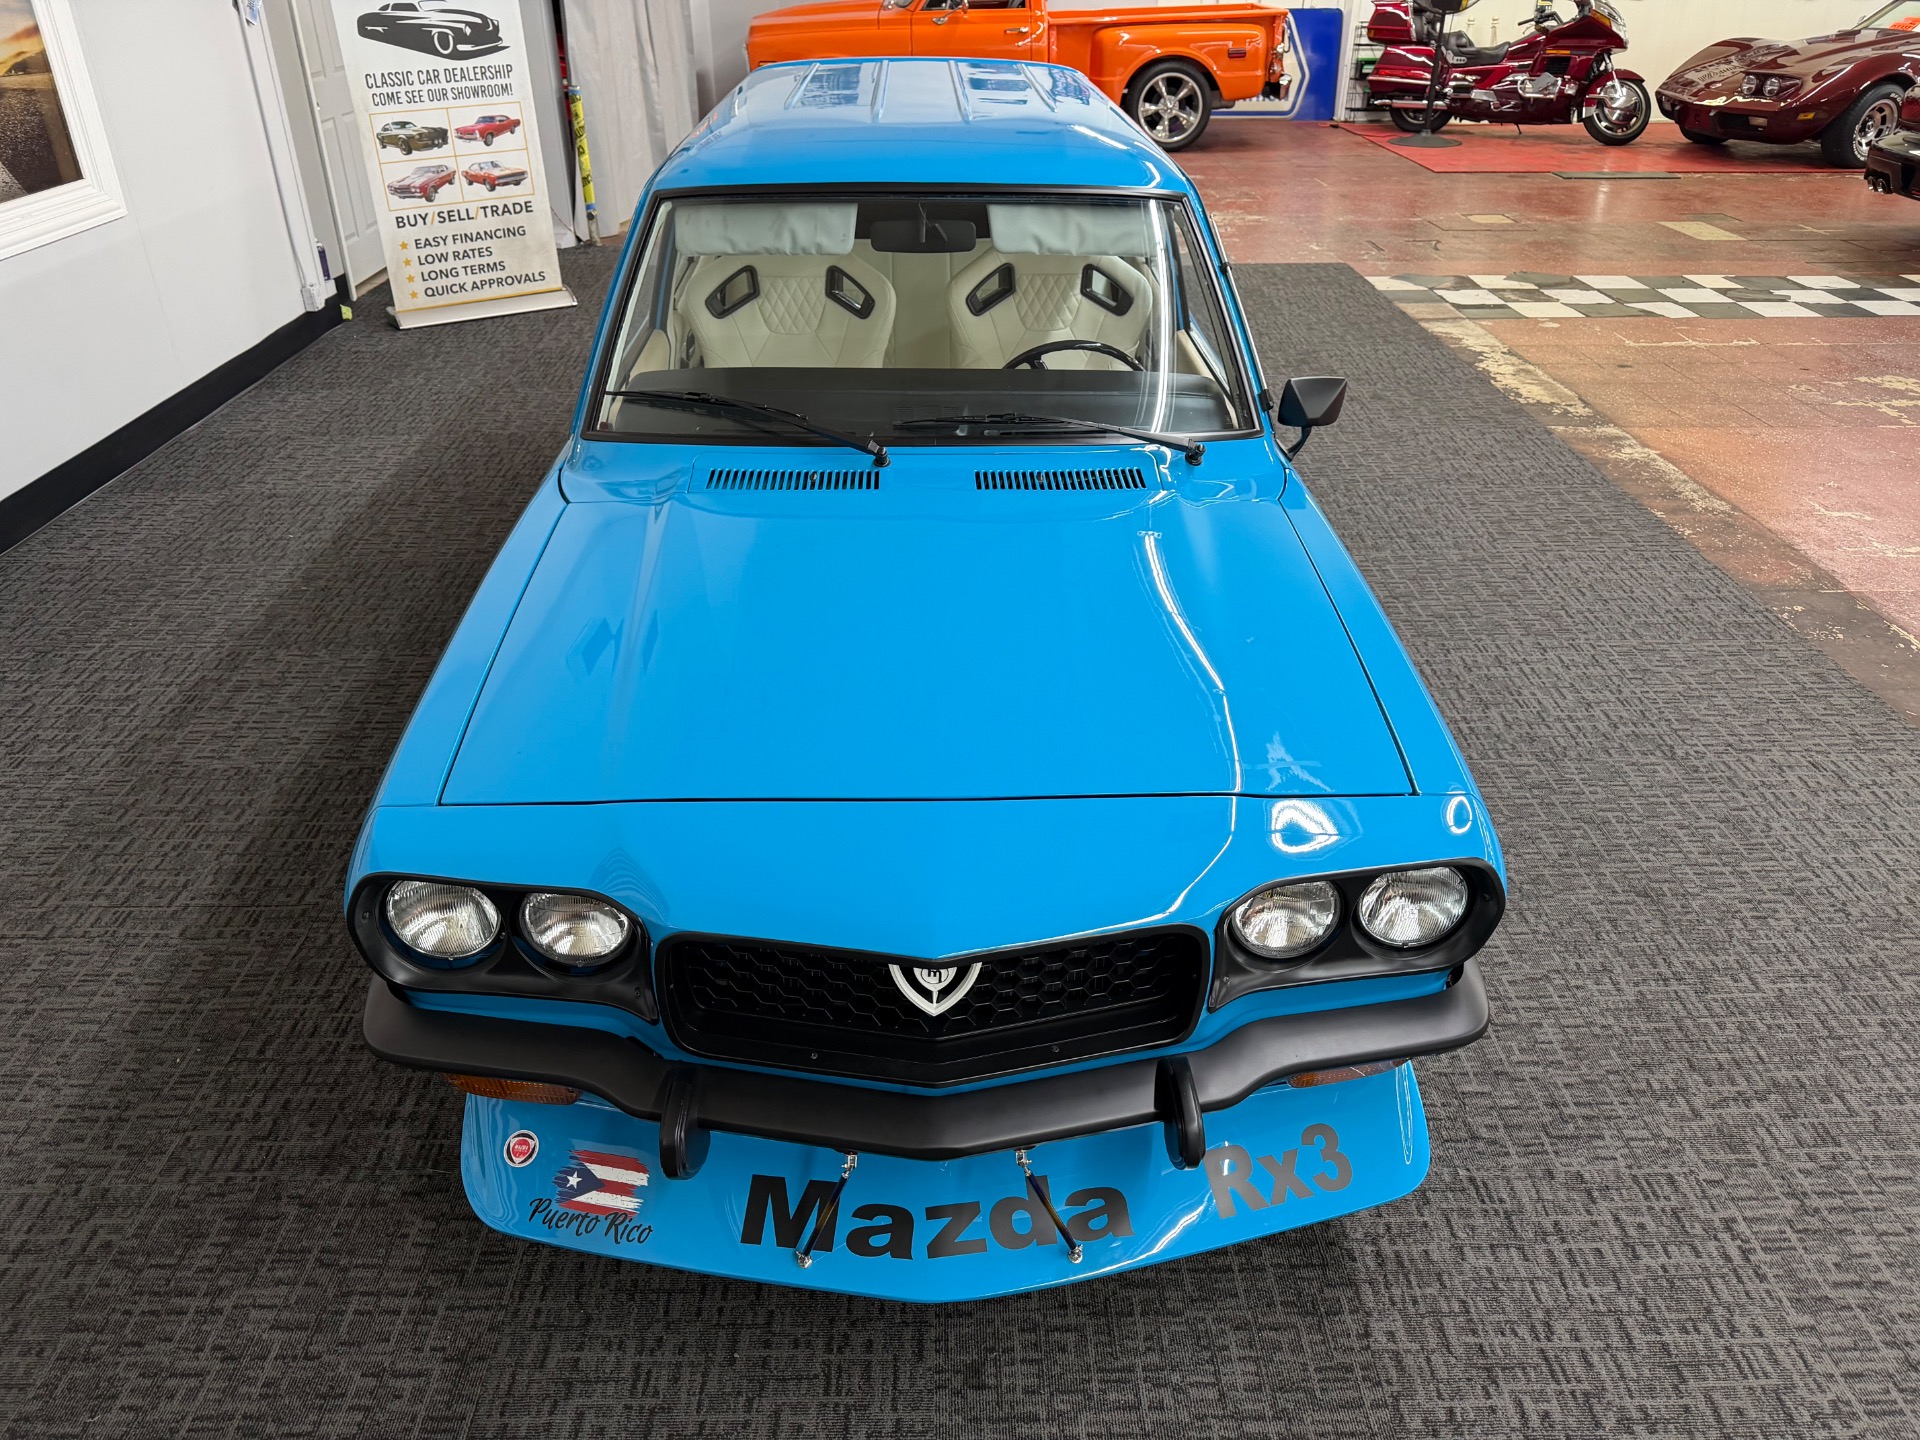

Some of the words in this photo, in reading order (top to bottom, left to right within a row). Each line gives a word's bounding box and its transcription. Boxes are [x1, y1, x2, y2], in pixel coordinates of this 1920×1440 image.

[364, 69, 415, 90] CLASSIC
[417, 67, 441, 85] CAR
[444, 63, 513, 84] DEALERSHIP
[371, 91, 404, 107] COME
[405, 89, 426, 104] SEE
[426, 87, 450, 103] OUR
[451, 82, 513, 100] SHOWROOM!
[395, 200, 534, 229] BUY/SELL/TRADE
[414, 234, 450, 250] EASY
[452, 225, 526, 246] FINANCING
[417, 252, 452, 267] LOW
[452, 246, 494, 262] RATES
[420, 267, 460, 283] LONG
[460, 260, 506, 276] TERMS
[424, 281, 468, 298] QUICK
[470, 271, 546, 293] APPROVALS
[740, 1173, 1135, 1261] Mazda
[1204, 1122, 1353, 1219] Rx3
[528, 1197, 602, 1236] Puerto
[601, 1210, 654, 1245] Rico
